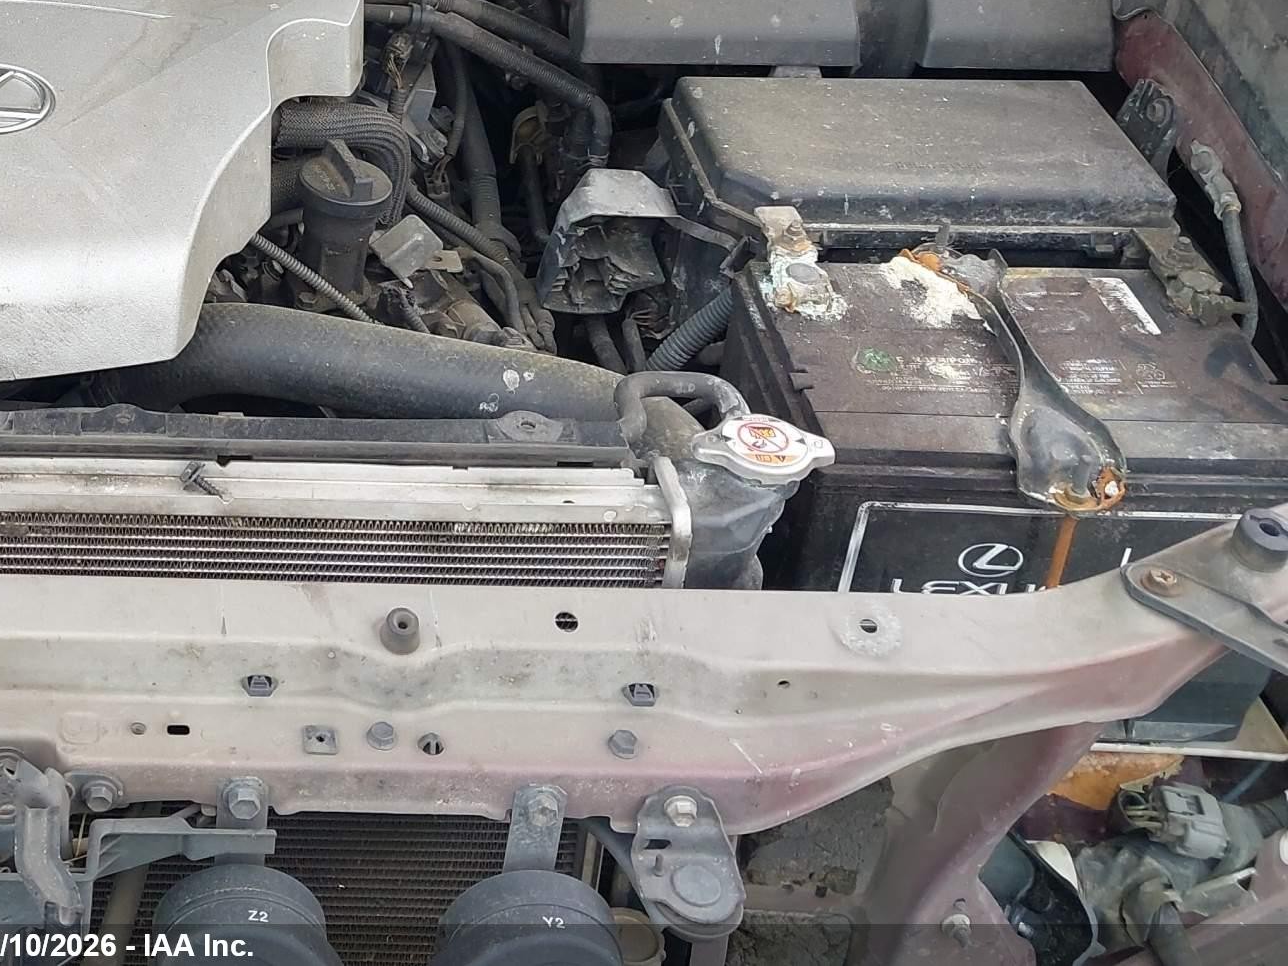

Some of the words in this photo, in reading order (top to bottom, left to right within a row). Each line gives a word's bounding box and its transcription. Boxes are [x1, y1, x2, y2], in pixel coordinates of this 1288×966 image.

[891, 578, 1048, 595] LEXU
[248, 910, 269, 923] Z2
[542, 916, 566, 929] Y2
